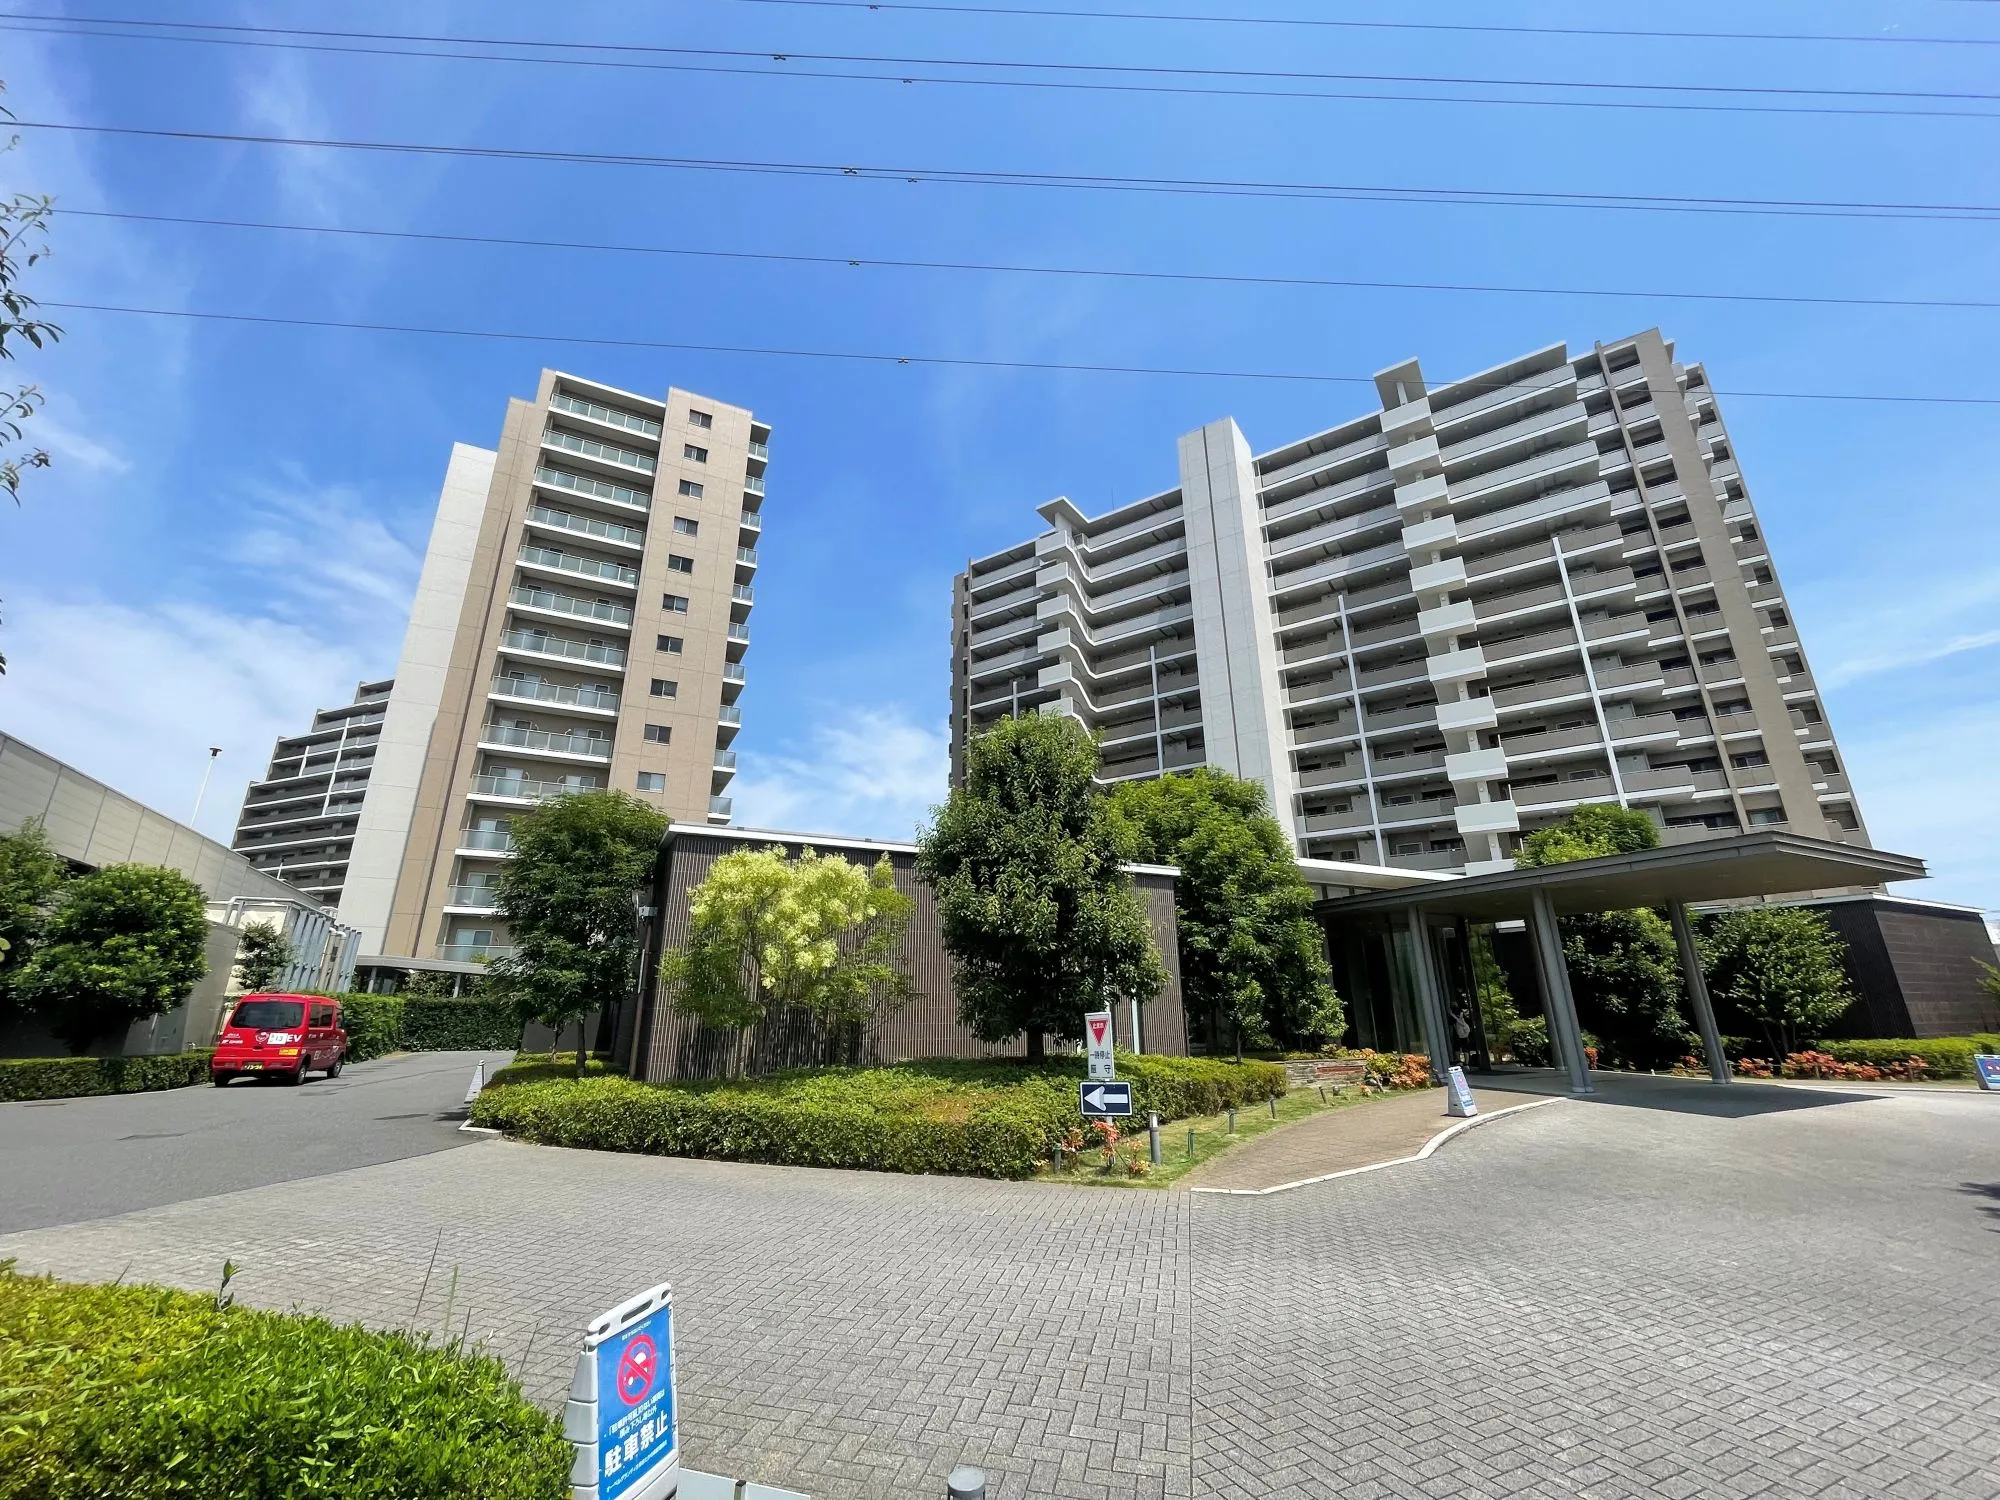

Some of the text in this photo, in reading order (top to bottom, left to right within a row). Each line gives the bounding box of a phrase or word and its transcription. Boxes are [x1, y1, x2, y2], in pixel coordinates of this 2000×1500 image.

[287, 1034, 302, 1043] EV
[605, 1409, 668, 1478] 駐車禁止
